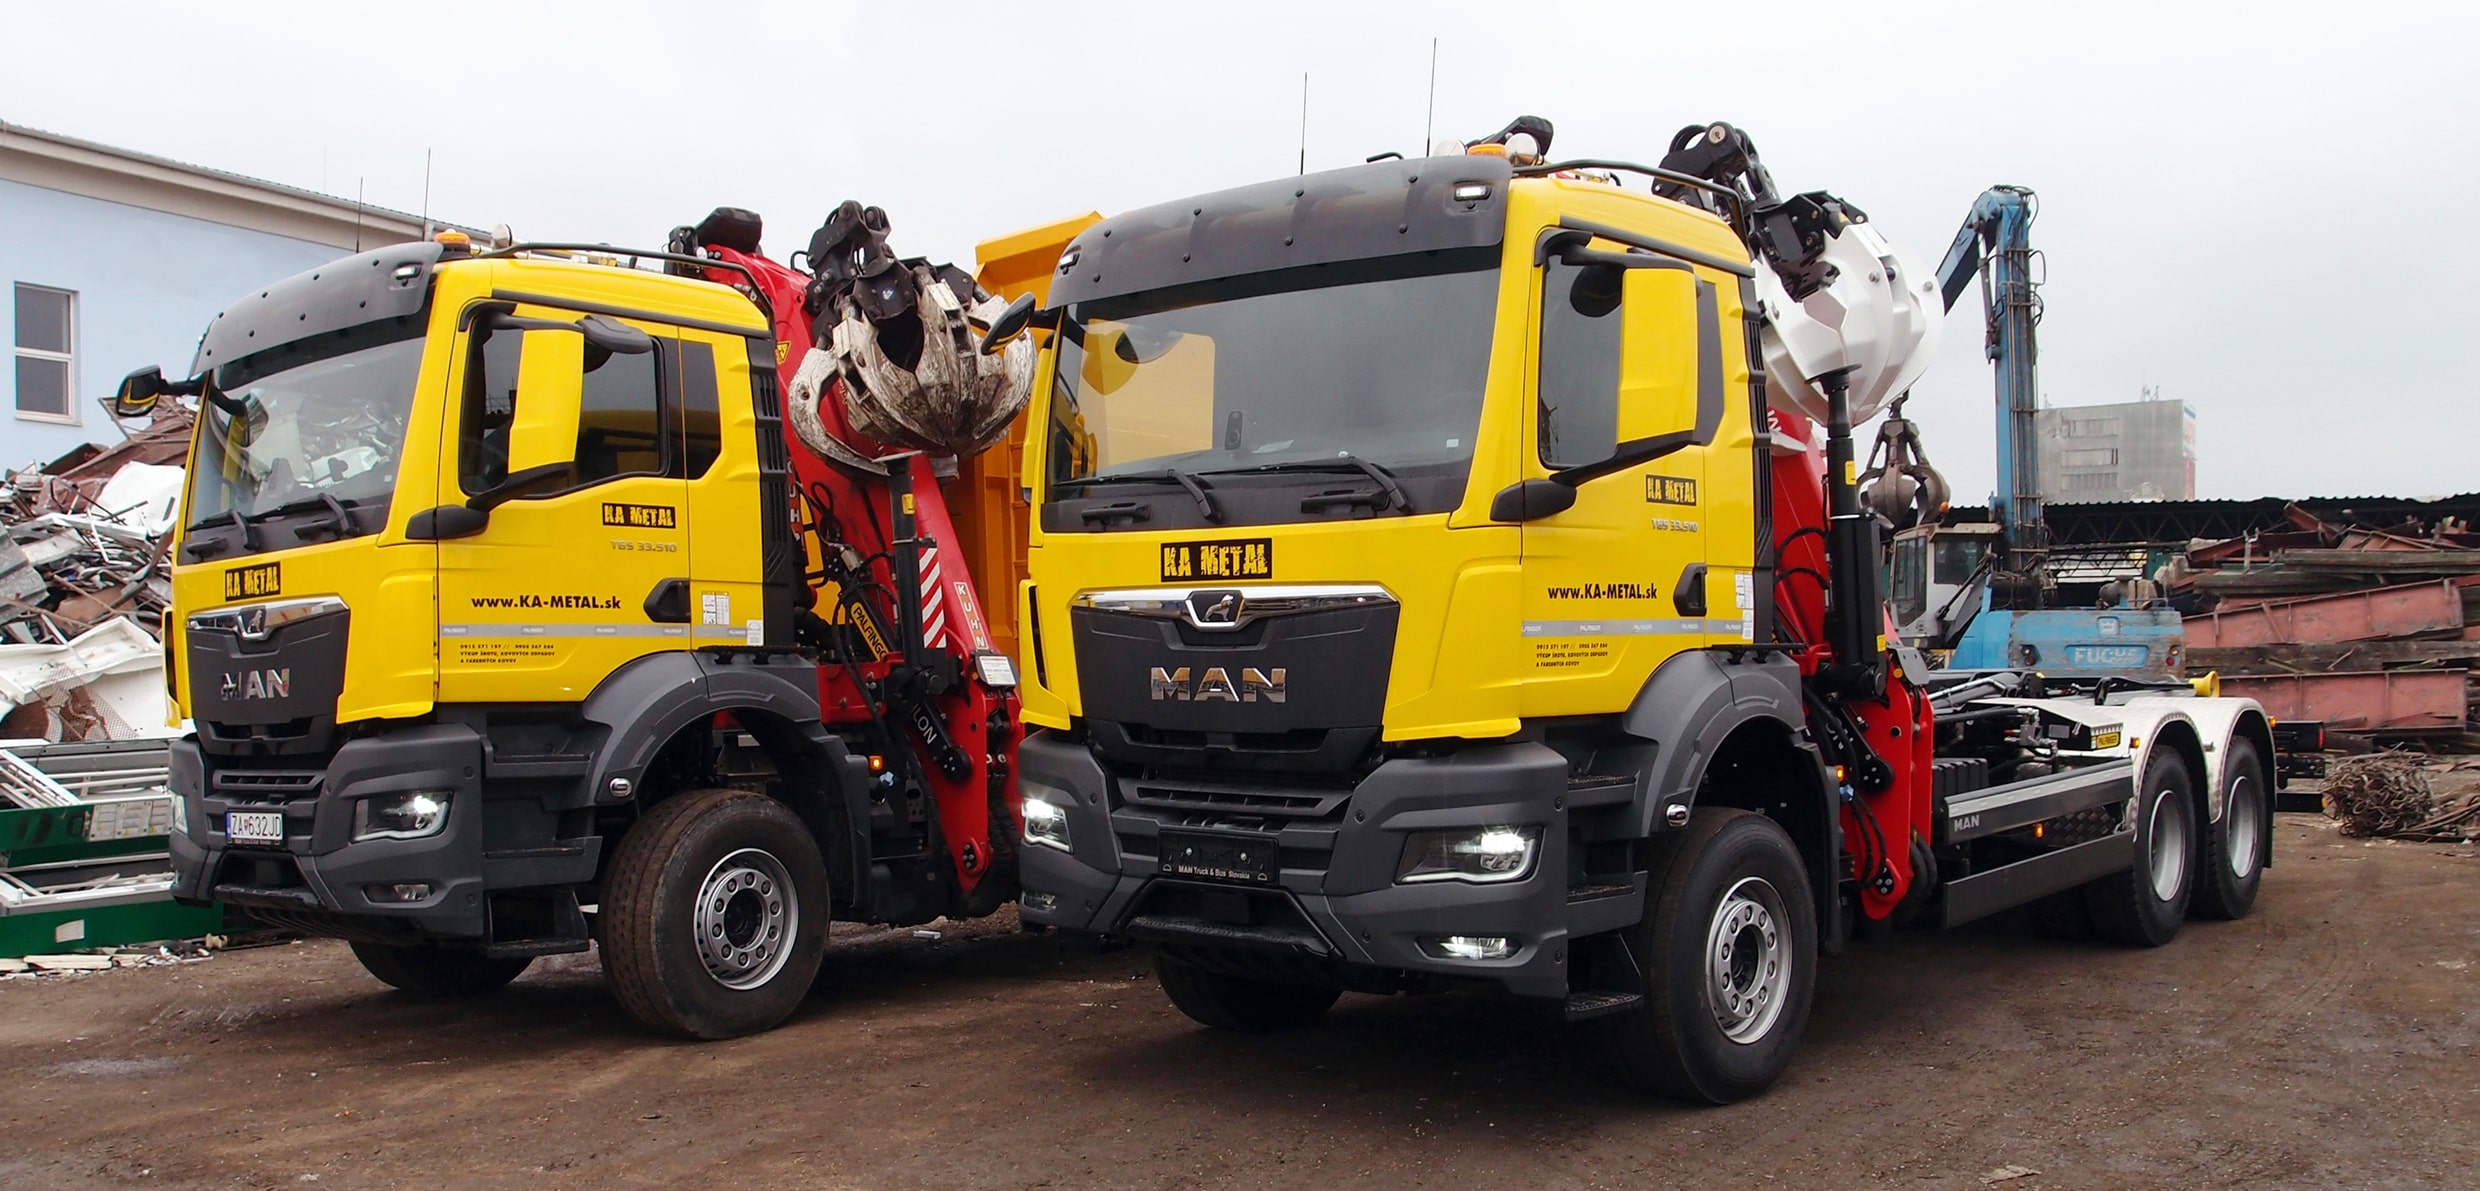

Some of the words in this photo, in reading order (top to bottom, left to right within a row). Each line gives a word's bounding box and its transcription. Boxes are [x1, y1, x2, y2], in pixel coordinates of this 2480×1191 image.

[1648, 477, 1662, 500] KA
[1665, 480, 1695, 503] METAL
[604, 505, 625, 524] KA
[630, 507, 674, 527] METAL
[611, 540, 634, 551] TGS
[637, 541, 677, 553] 33.510
[1164, 547, 1192, 577] KA
[1200, 544, 1268, 577] METAL
[226, 572, 241, 597] KA
[244, 566, 279, 595] METAL
[1548, 583, 1657, 599] www.KA-METAL.sk
[471, 595, 621, 609] www.KA-METAL.sk
[957, 584, 986, 648] KUHN
[222, 668, 290, 700] MAN
[1151, 667, 1287, 703] MAN
[911, 703, 938, 745] ILON
[1954, 814, 1980, 832] MAN
[1178, 865, 1193, 874] MAN
[1194, 867, 1208, 875] Truck
[1209, 868, 1215, 876] &
[1215, 869, 1227, 877] Bus
